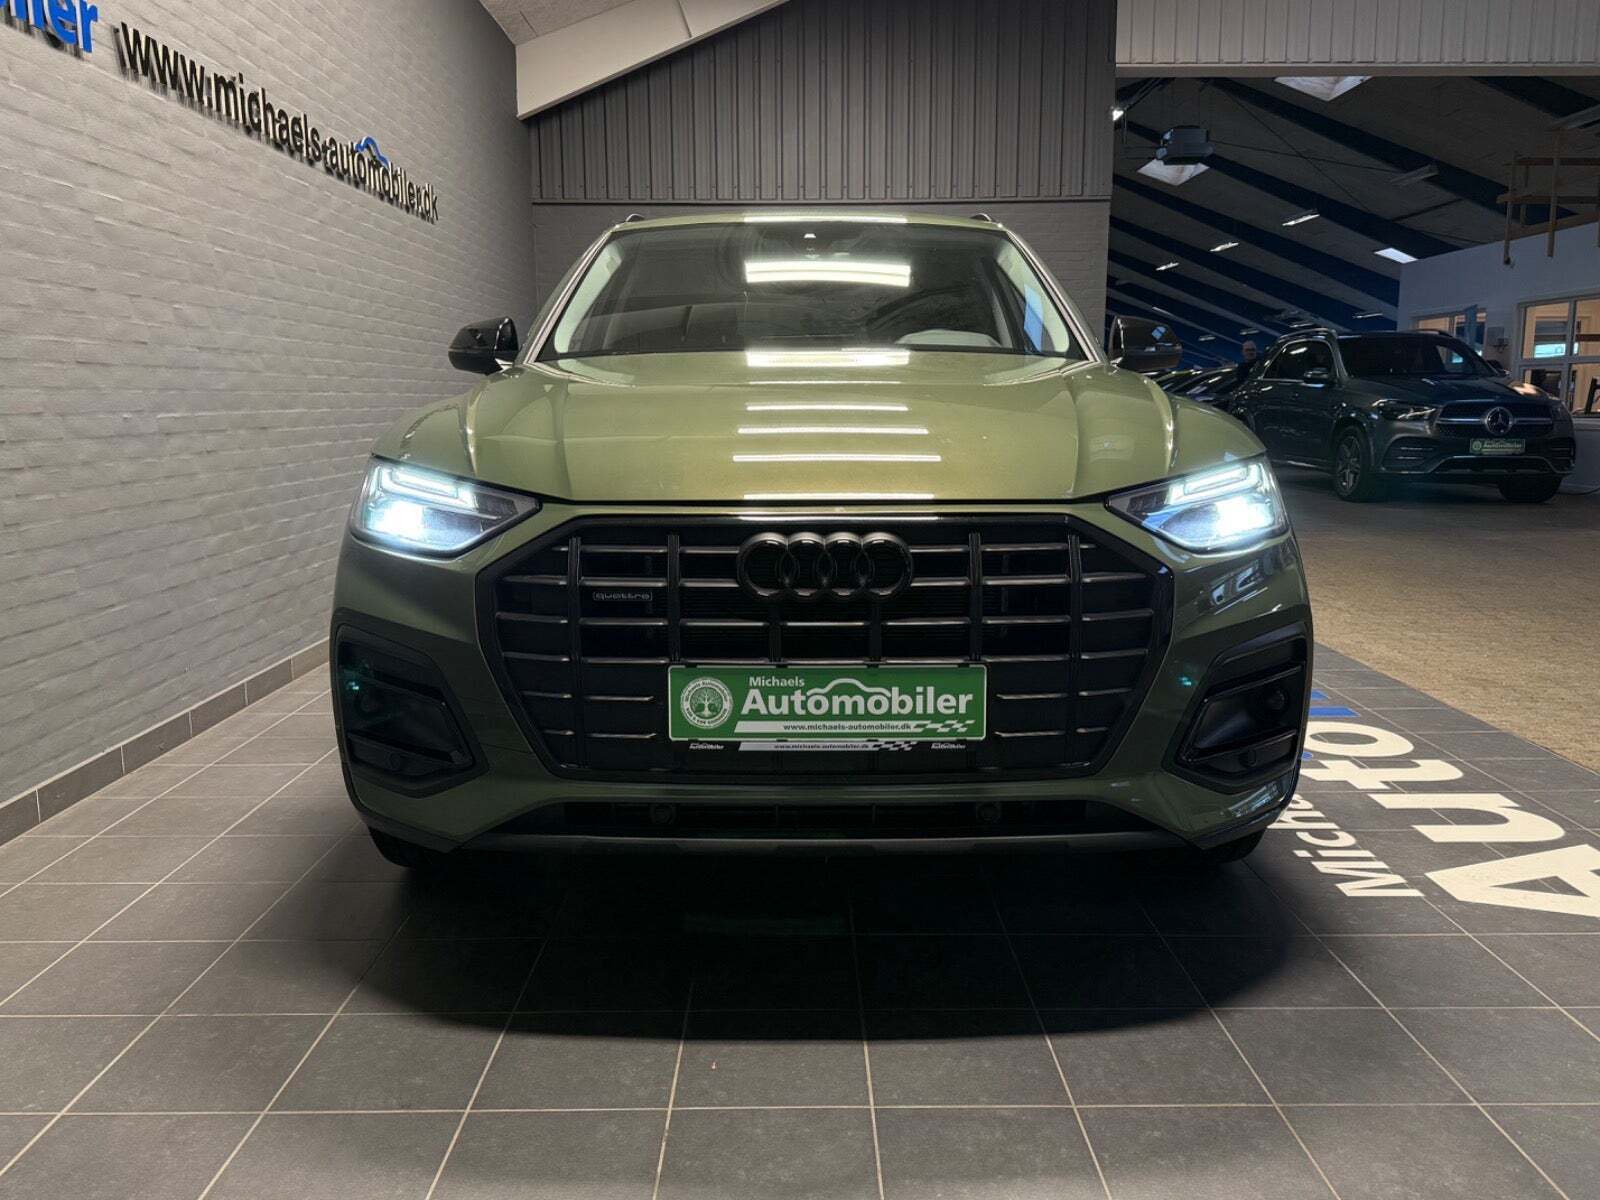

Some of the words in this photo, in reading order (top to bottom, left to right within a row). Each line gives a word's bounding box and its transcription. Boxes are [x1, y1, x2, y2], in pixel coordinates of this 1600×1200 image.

[119, 21, 438, 221] www.michaels-automobiler.dk
[594, 592, 650, 601] quattro
[749, 676, 805, 687] Michaels
[741, 686, 973, 715] Automobiler
[783, 723, 911, 731] www.michaels-automobiler.dk
